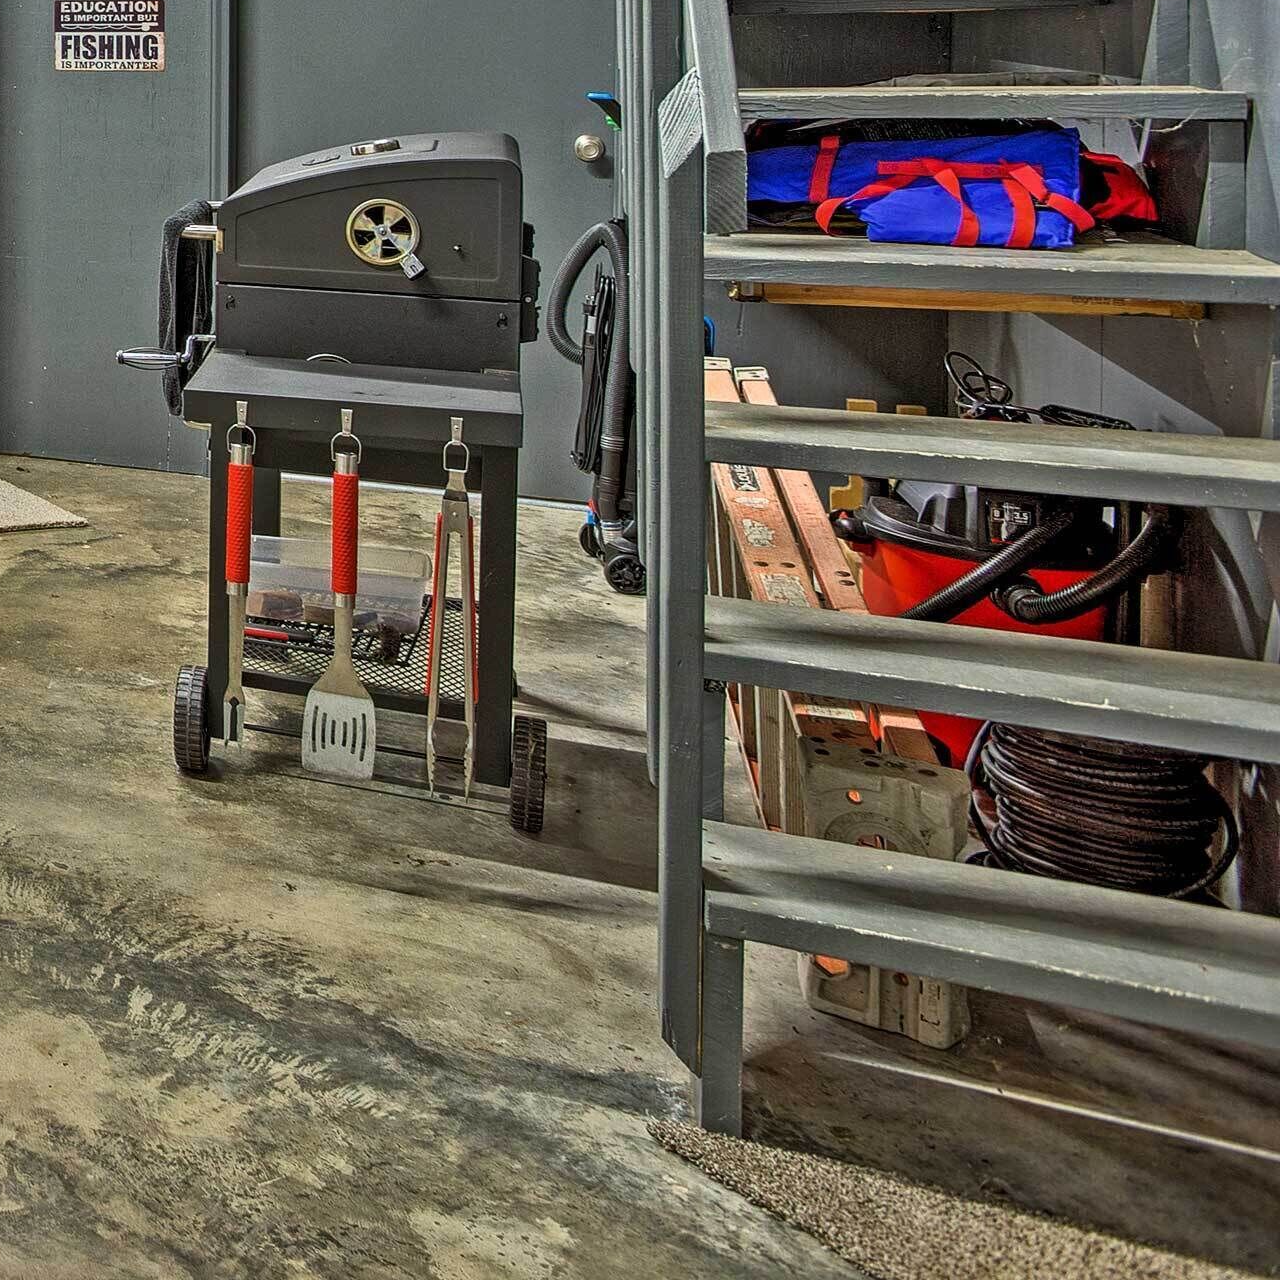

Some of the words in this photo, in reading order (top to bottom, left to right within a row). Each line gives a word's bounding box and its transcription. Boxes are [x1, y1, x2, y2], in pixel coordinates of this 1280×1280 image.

[60, 1, 159, 13] EDUCATION
[60, 14, 70, 22] IS
[74, 14, 134, 22] IMPORTANT
[137, 14, 159, 22] BUT
[61, 34, 159, 61] FISHING
[61, 61, 72, 69] IS
[75, 61, 158, 70] IMPORTANTER
